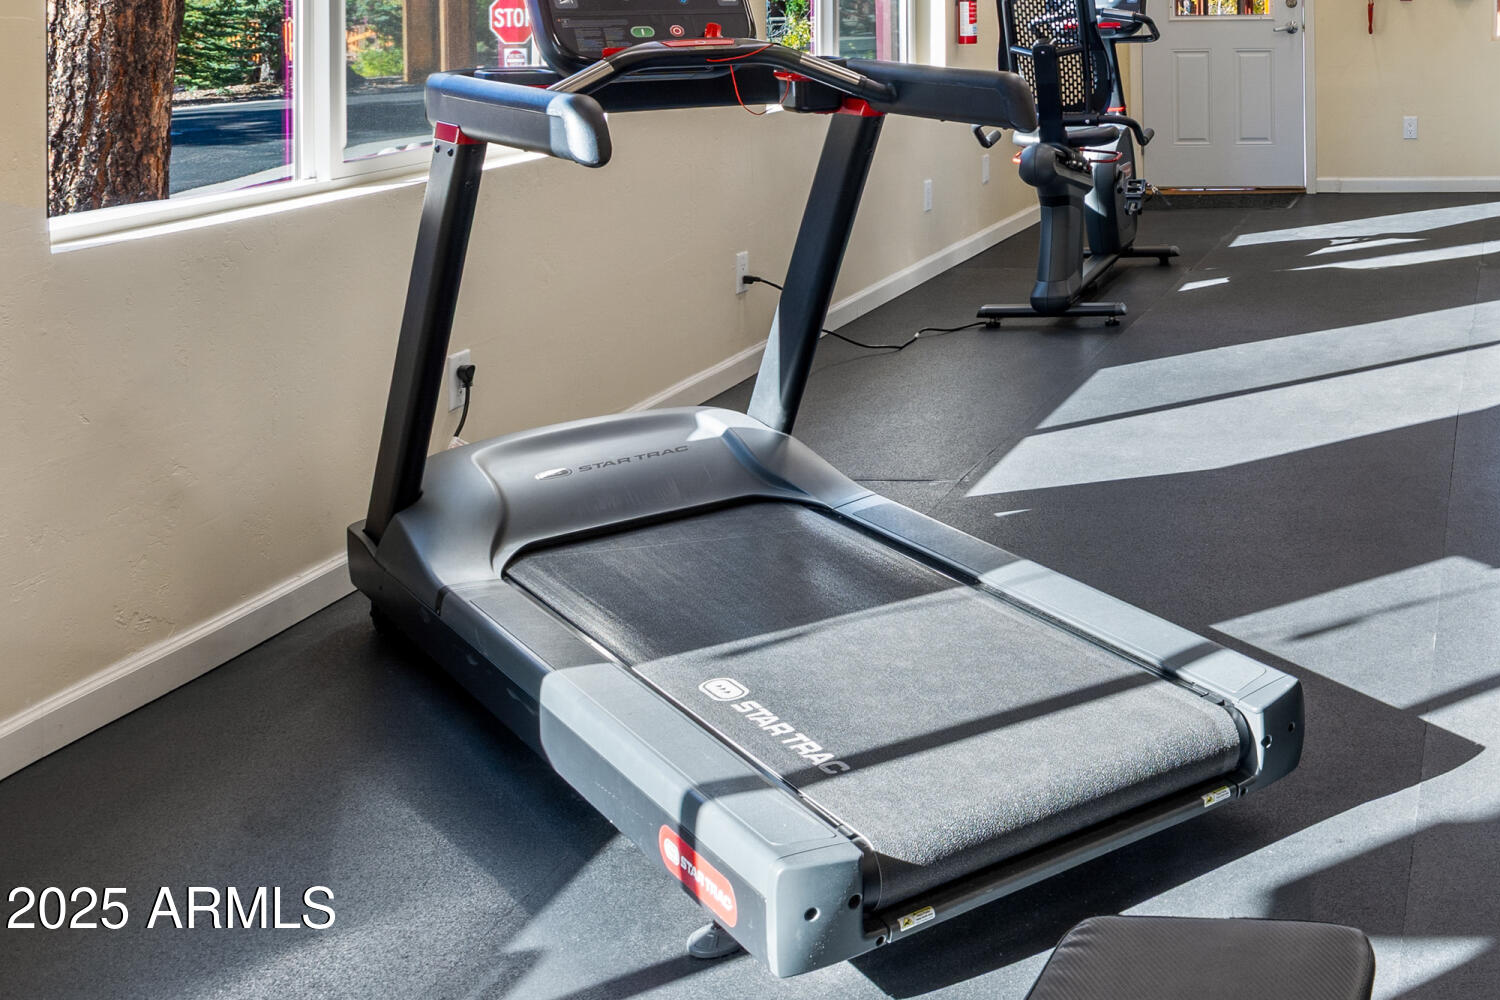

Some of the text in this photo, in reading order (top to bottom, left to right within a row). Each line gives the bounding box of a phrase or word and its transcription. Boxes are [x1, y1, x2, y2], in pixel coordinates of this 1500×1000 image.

[579, 445, 689, 472] STAR TRAC
[731, 700, 850, 775] STAR TRAC
[680, 855, 733, 912] STAR TRAC
